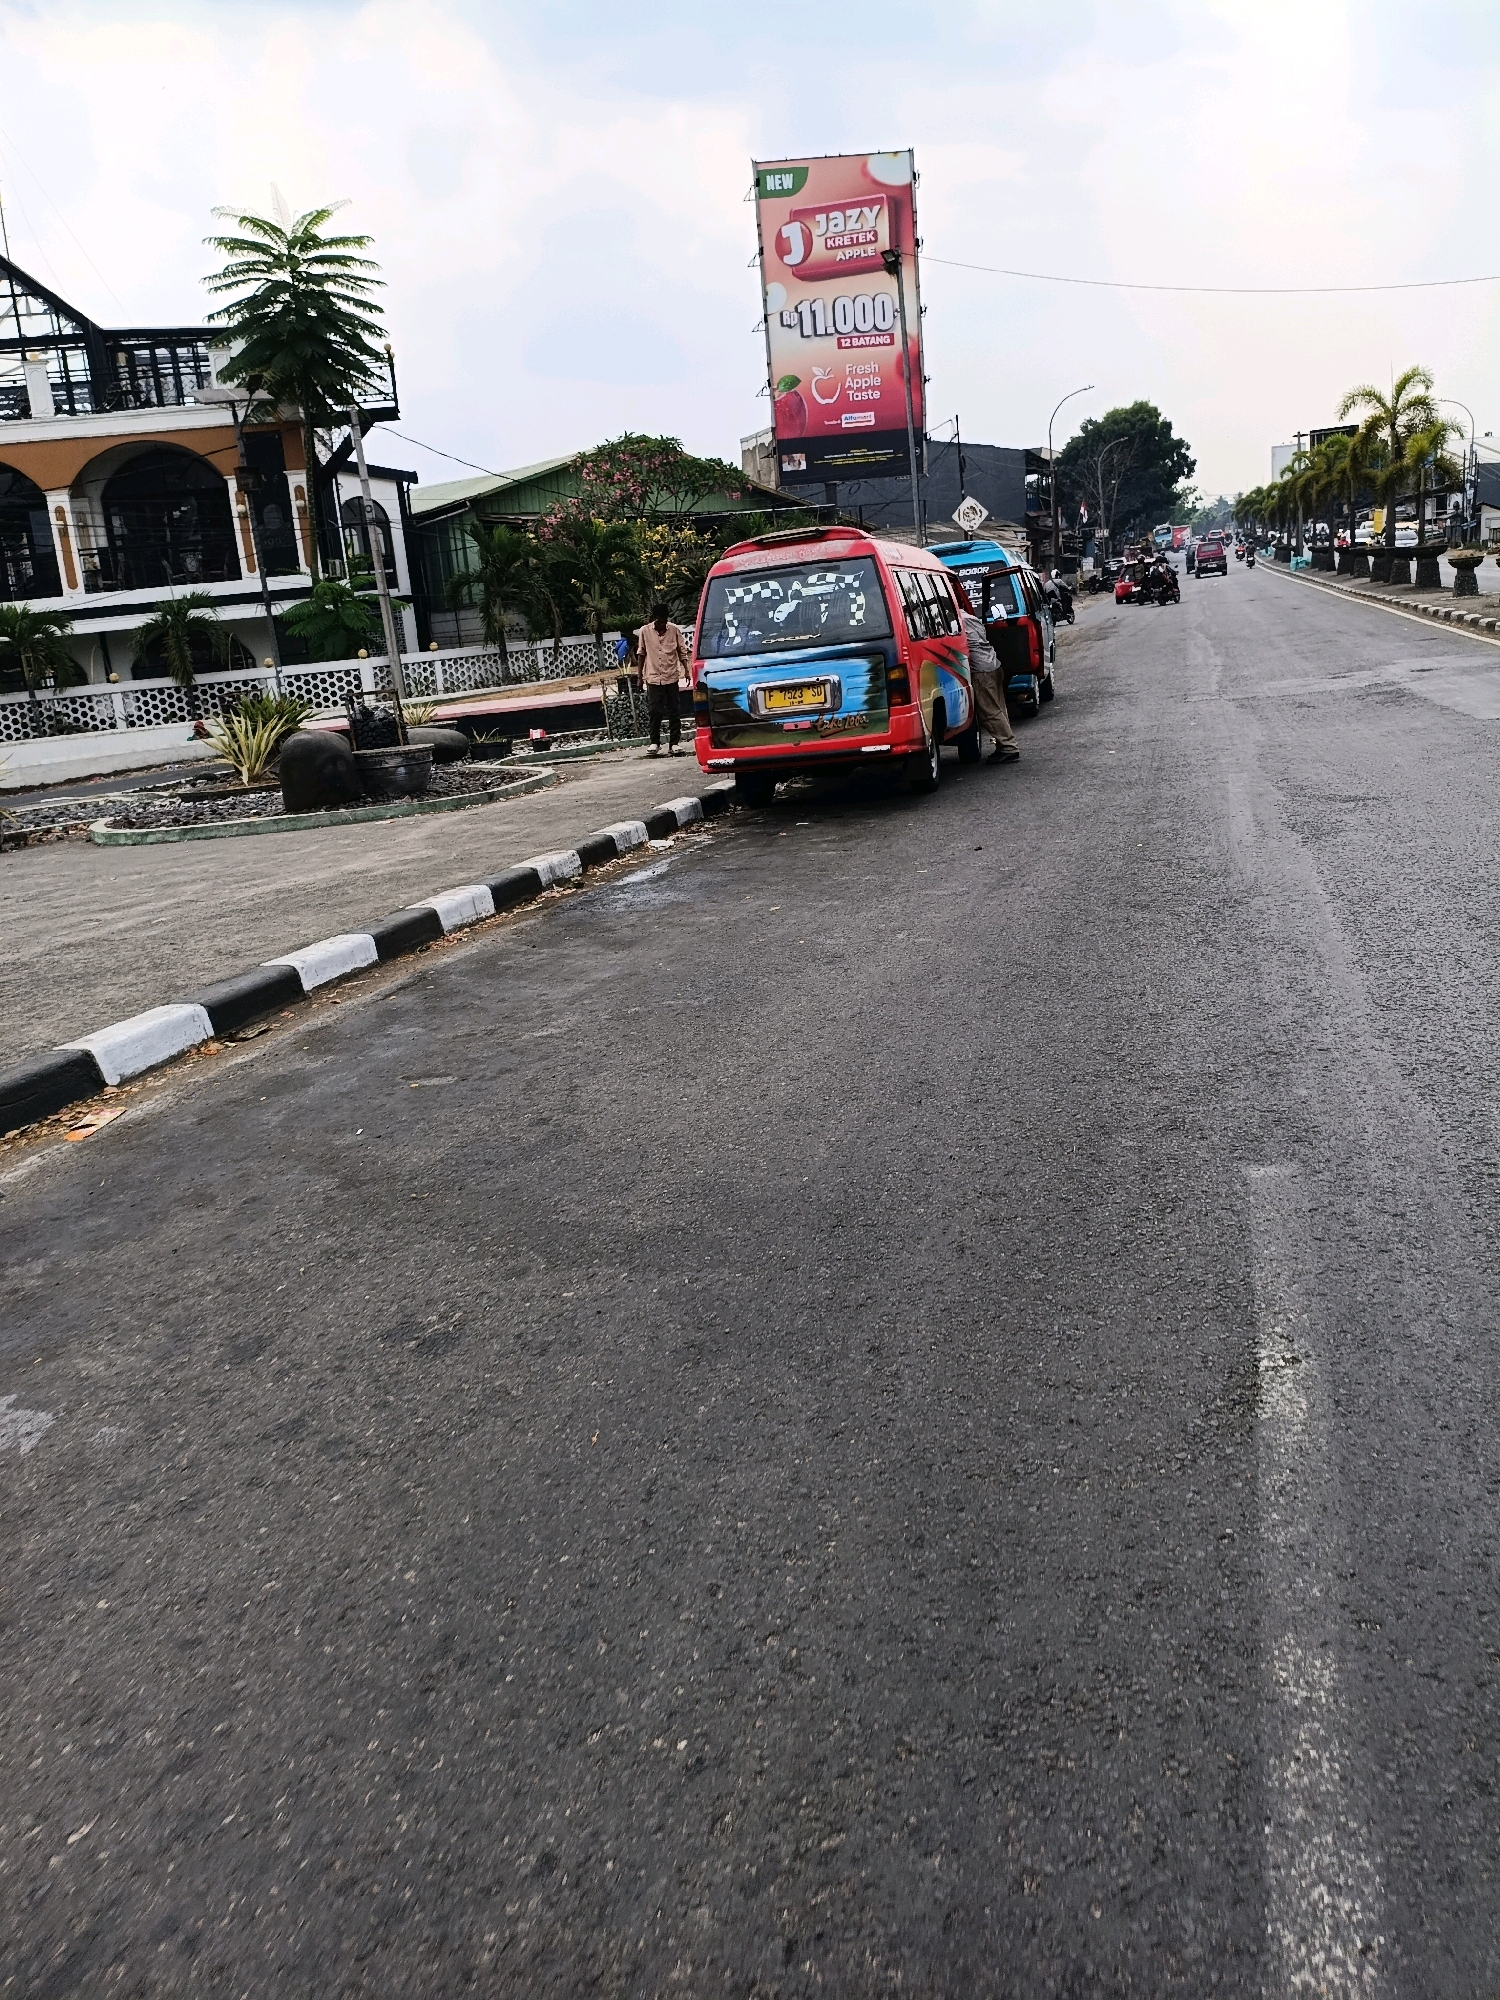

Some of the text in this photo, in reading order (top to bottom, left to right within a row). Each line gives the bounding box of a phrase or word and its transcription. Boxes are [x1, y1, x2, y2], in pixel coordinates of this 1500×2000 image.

[766, 173, 794, 191] NEW
[826, 231, 876, 249] KRETEK
[836, 246, 876, 262] APPLE
[840, 335, 891, 348] 12 BATANG
[845, 361, 879, 375] Fresh
[845, 375, 881, 390] Apple
[846, 389, 881, 402] Taste
[958, 566, 990, 577] BOGOR
[768, 690, 774, 702] F
[782, 687, 804, 701] 7523
